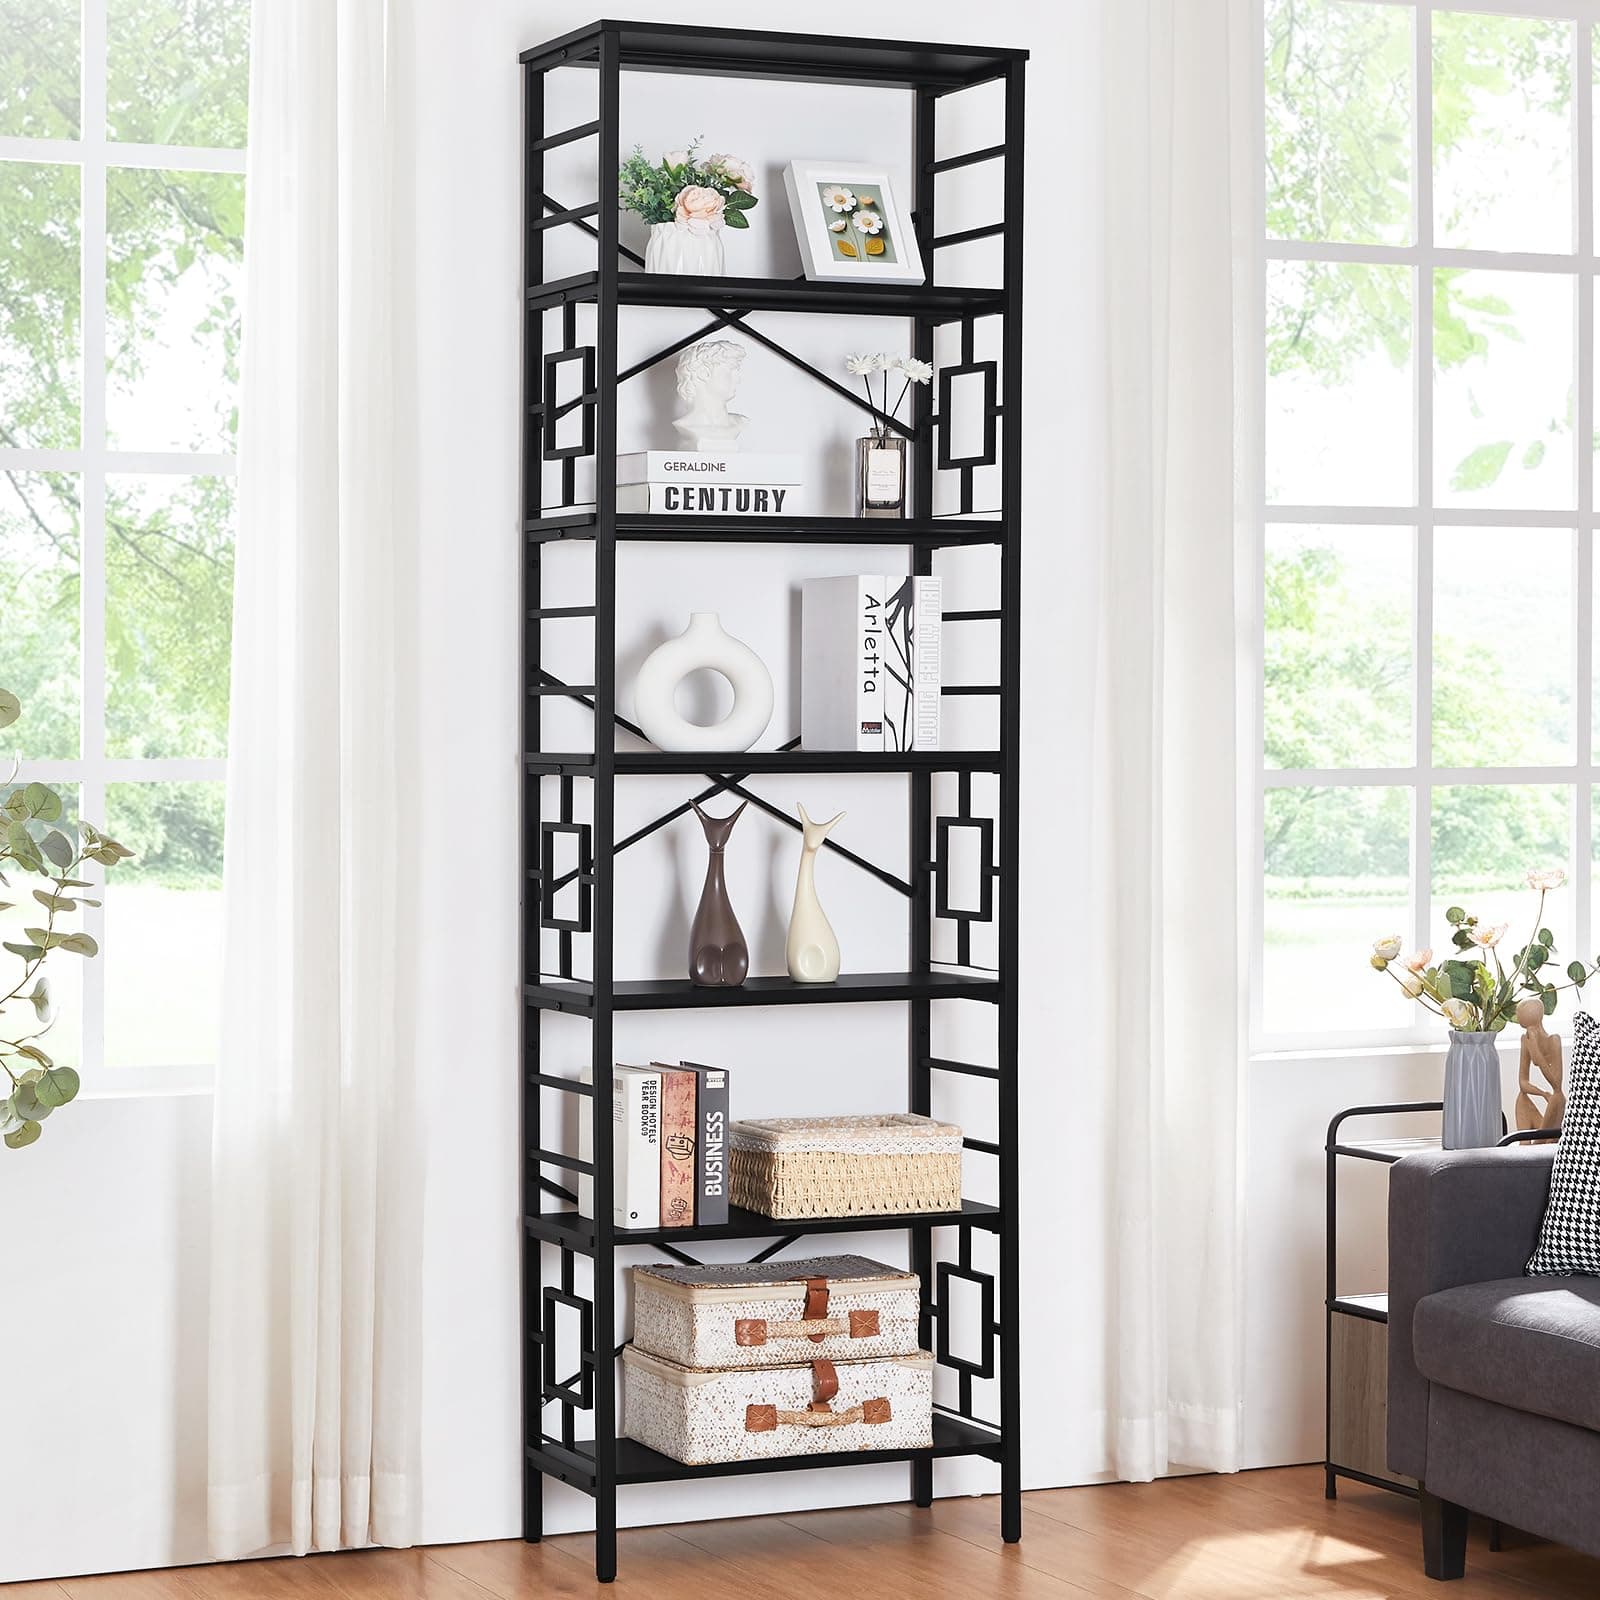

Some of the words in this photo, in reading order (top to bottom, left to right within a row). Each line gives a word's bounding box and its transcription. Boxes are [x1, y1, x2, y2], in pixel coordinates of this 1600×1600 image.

[663, 461, 726, 473] GERALDINE
[664, 486, 786, 513] CENTURY
[863, 594, 882, 694] Arletta
[641, 1080, 649, 1101] YEAR
[649, 1080, 657, 1110] DESIGN
[648, 1112, 657, 1144] HOTELS
[705, 1111, 724, 1196] BUSINESS
